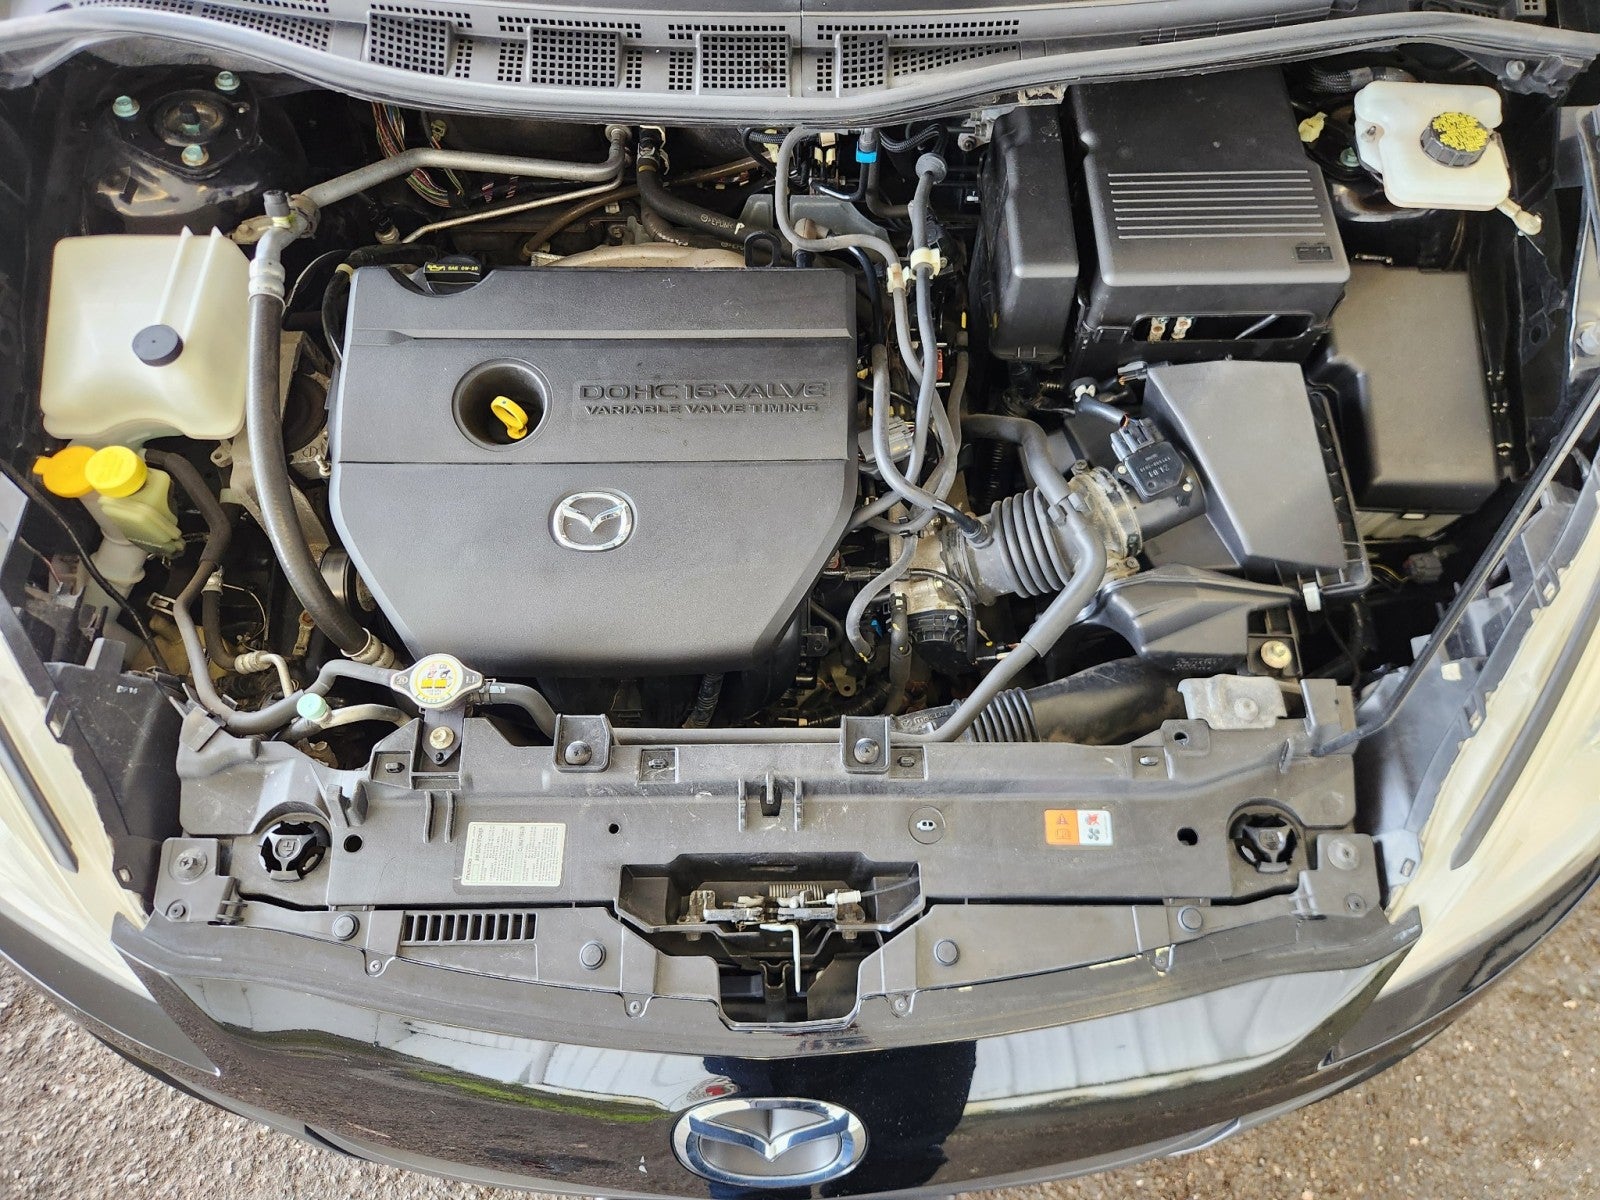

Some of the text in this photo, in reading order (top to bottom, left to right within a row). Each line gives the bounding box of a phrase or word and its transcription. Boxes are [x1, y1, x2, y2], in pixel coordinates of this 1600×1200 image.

[579, 382, 827, 400] DOHC 16-VALVE
[584, 402, 819, 415] VARIABLE VALVE TIMING
